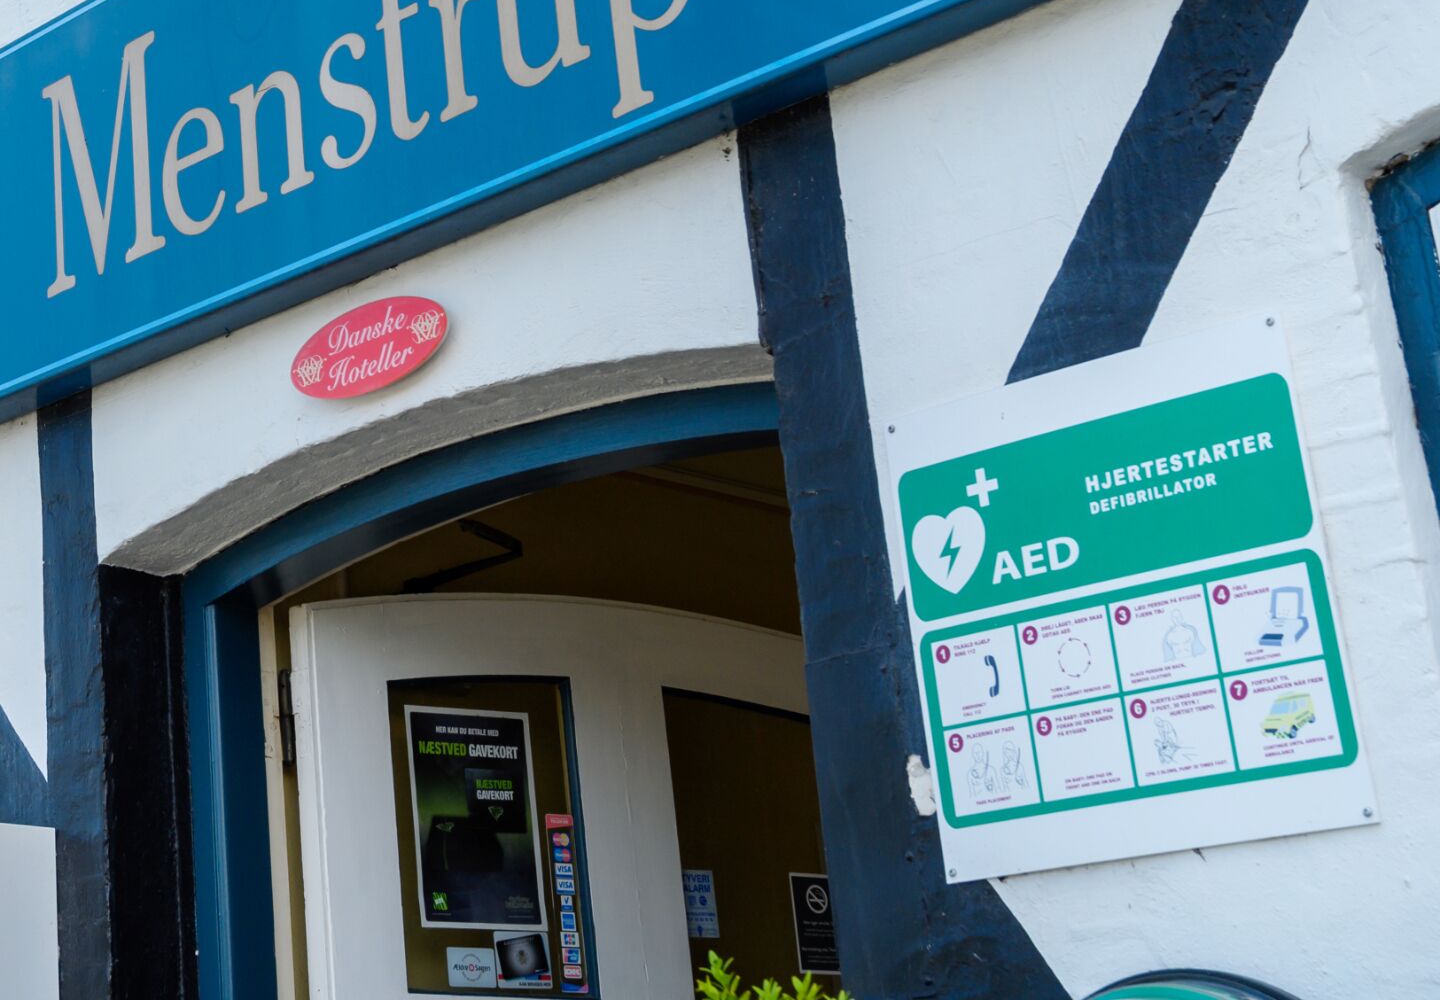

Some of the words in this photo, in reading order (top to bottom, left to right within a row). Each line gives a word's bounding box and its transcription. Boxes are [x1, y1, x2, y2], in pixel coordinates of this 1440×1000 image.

[327, 306, 408, 356] Danske
[327, 341, 413, 391] Hoteller
[1084, 431, 1274, 493] HJERTESTARTER
[1089, 473, 1218, 515] DEFIBRILLATOR
[992, 536, 1080, 585] AED
[418, 740, 467, 756] NÆSTVED
[468, 743, 518, 759] GAVEKORT
[476, 790, 514, 801] GAVEKORT
